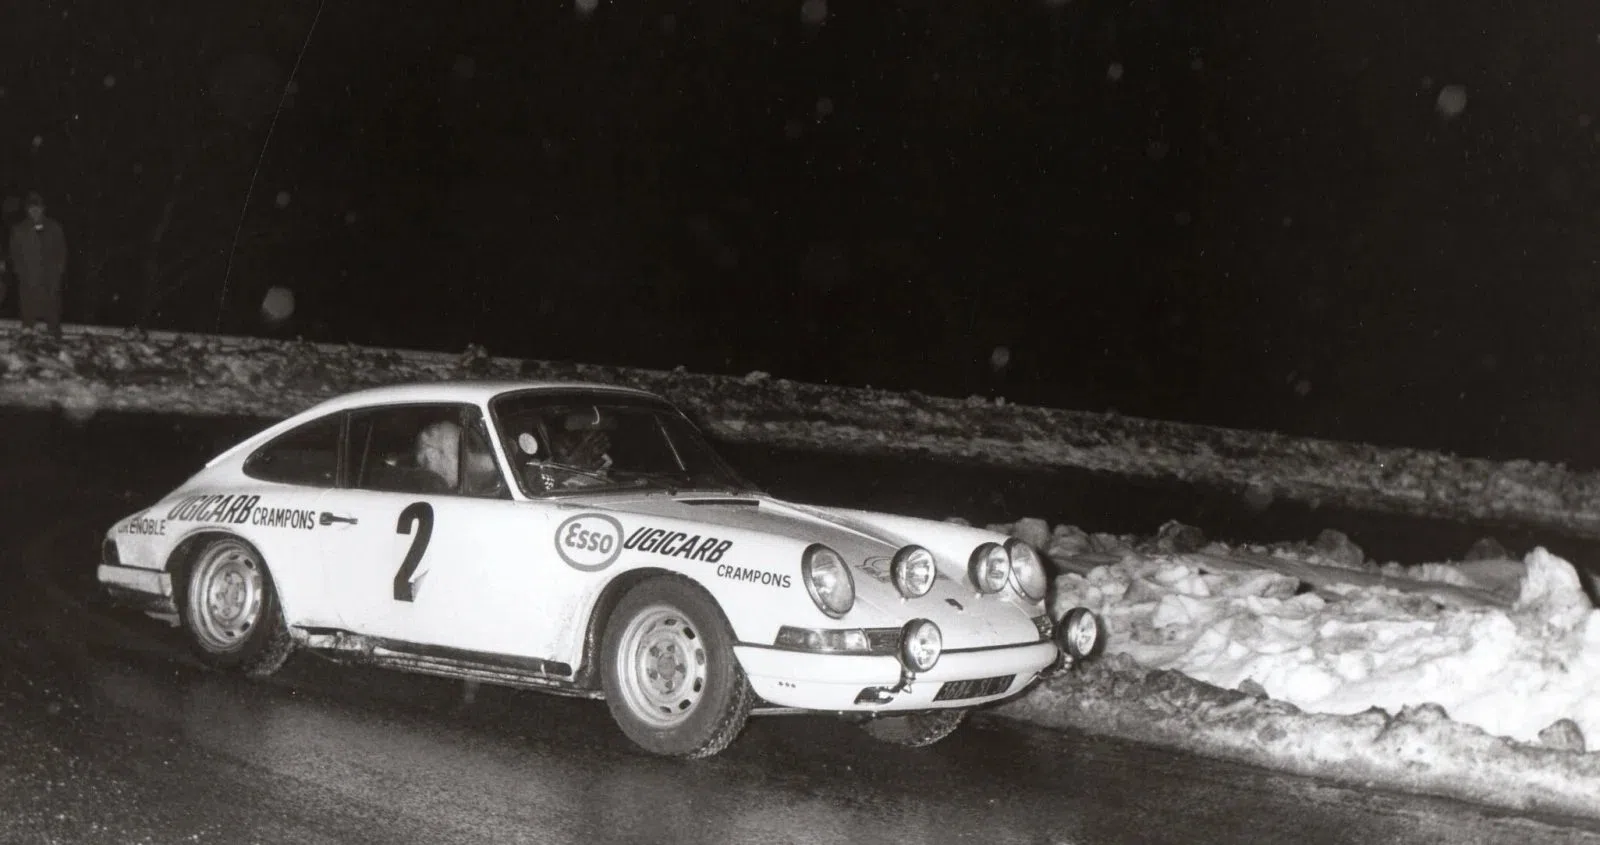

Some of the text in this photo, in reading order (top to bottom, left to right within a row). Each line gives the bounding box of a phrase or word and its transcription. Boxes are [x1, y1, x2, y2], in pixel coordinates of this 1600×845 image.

[167, 495, 315, 530] UGICARB CRAMPONS
[393, 501, 434, 602] 2
[623, 526, 733, 563] UGICARB
[717, 564, 791, 588] CRAMPONS
